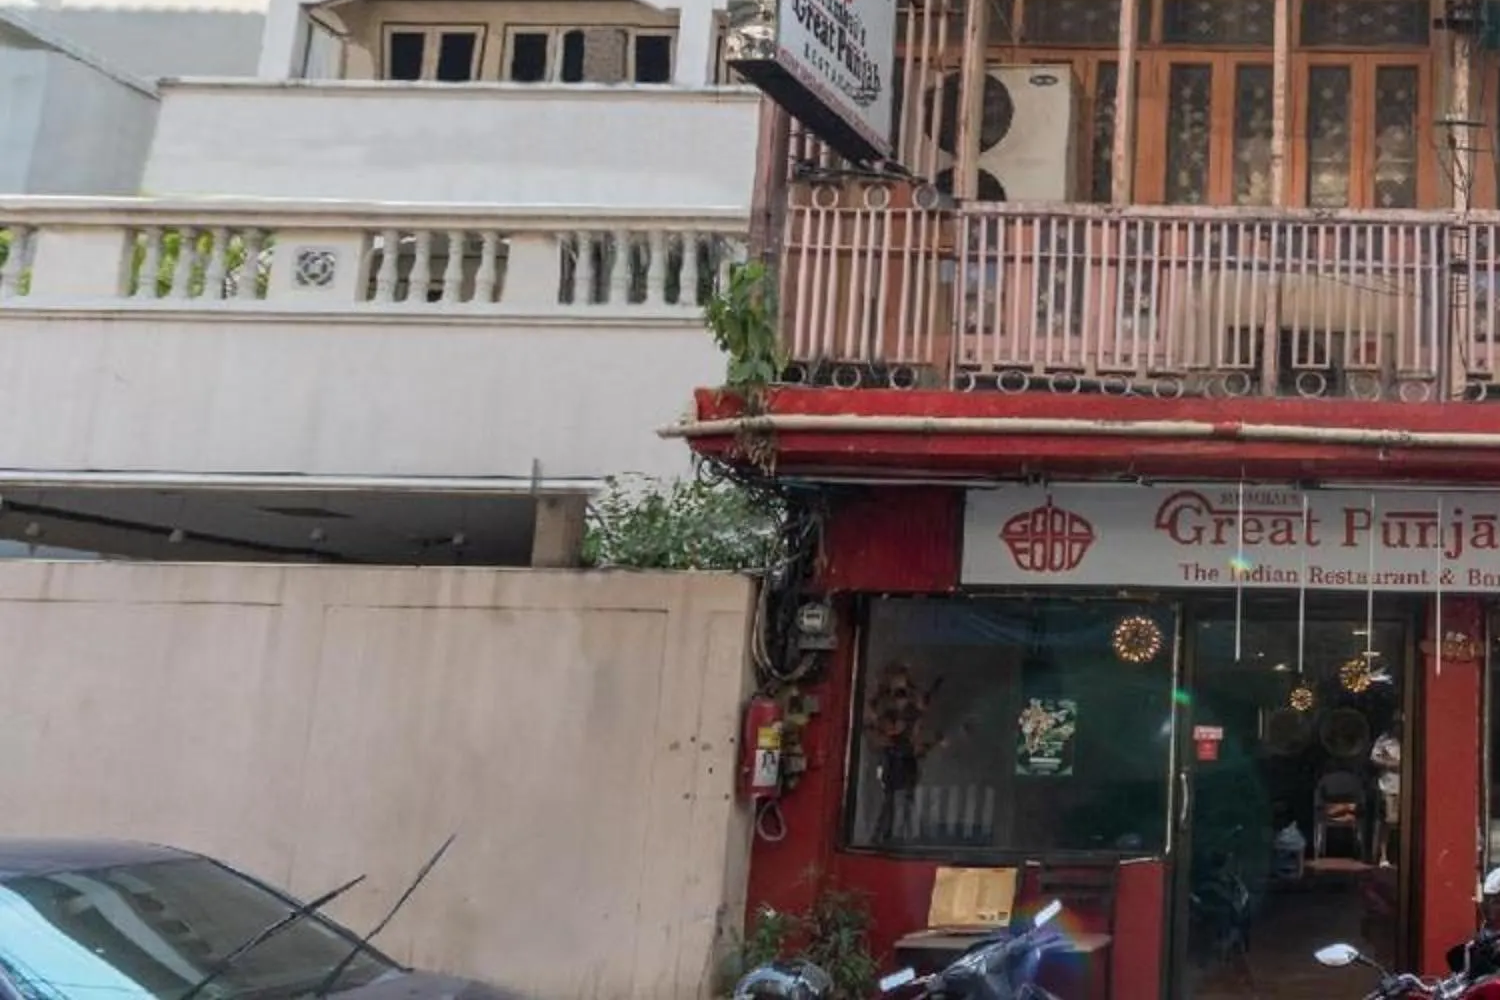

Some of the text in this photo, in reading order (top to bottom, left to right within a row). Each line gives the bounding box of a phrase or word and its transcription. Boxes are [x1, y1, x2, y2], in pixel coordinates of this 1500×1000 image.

[1155, 491, 1322, 546] Great
[1179, 563, 1220, 582] The
[1229, 565, 1300, 584] Indian
[1308, 565, 1430, 586] Restaurant
